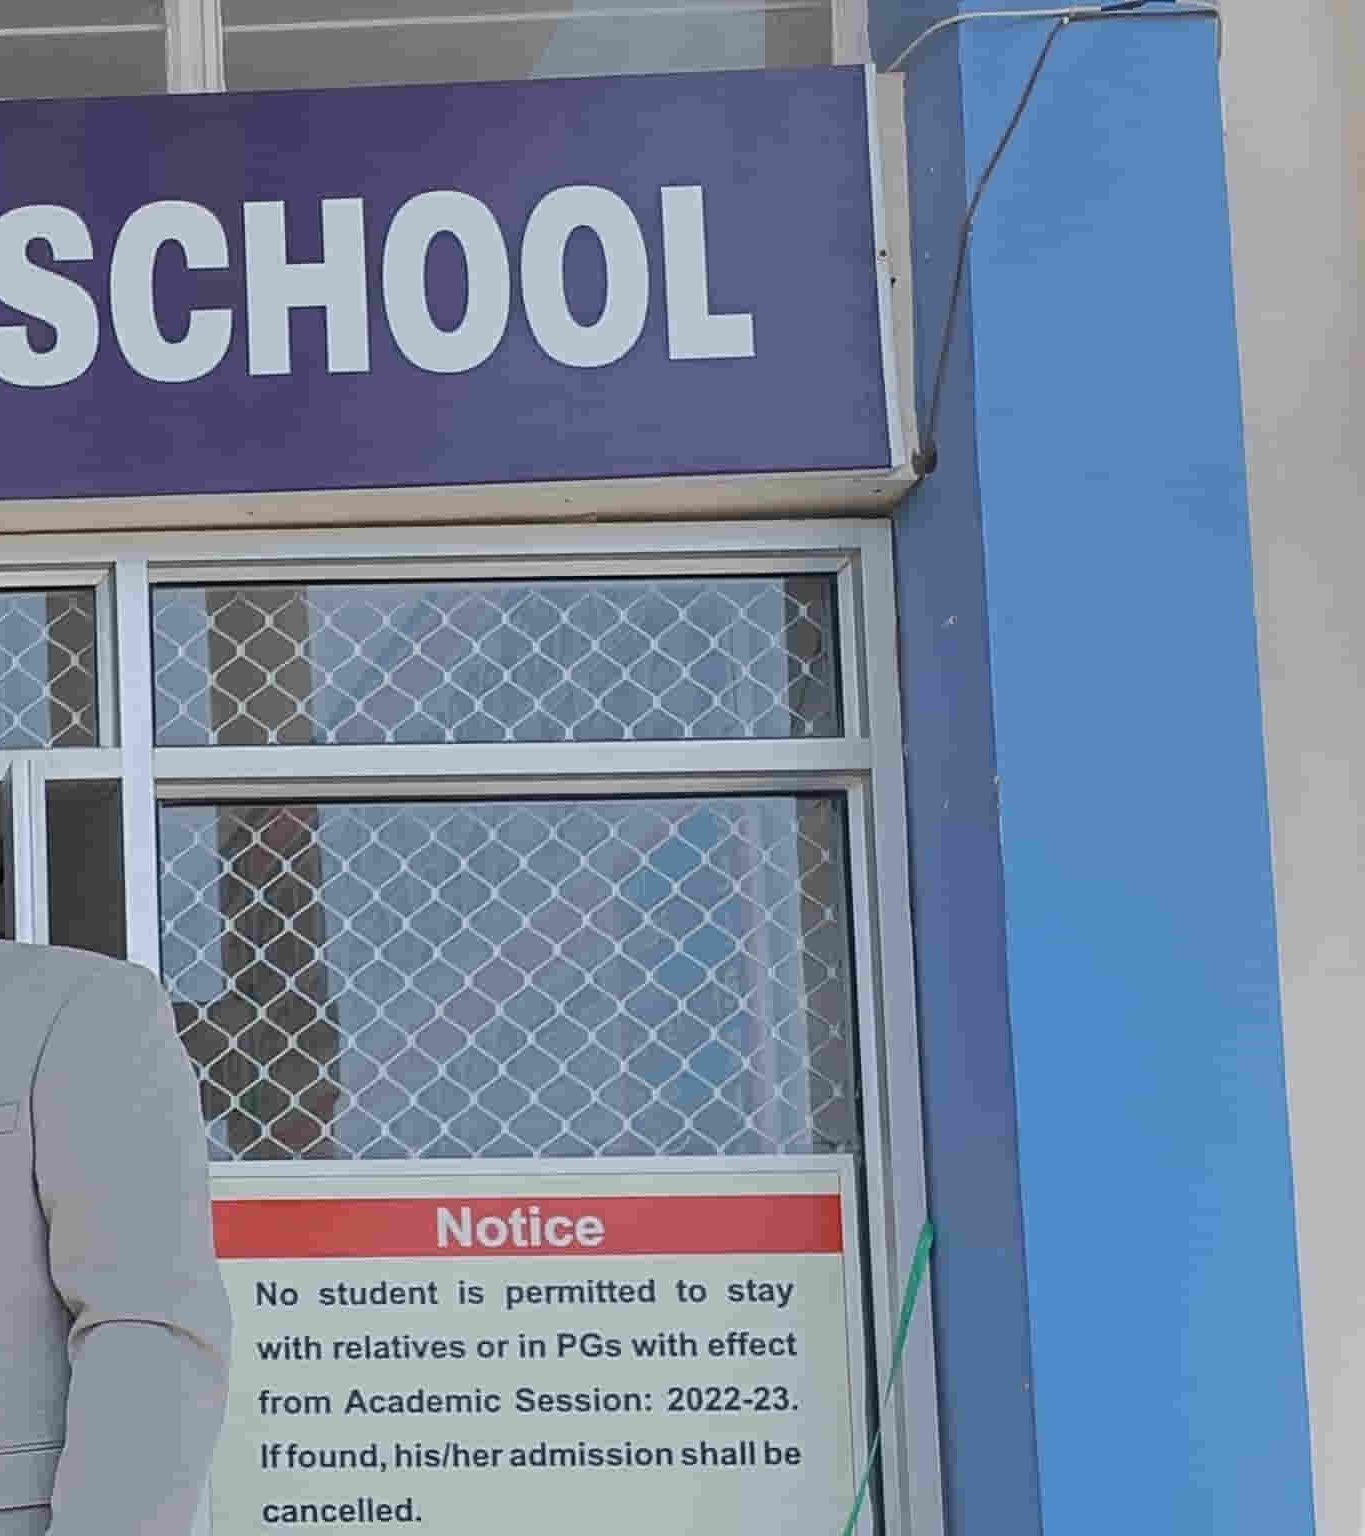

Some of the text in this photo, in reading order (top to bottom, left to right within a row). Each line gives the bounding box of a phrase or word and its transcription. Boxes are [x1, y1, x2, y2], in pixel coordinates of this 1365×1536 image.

[437, 1206, 604, 1248] Notice
[257, 1279, 793, 1310] No student is permitted to stay
[257, 1332, 797, 1360] with relatives or in PGs with effect
[258, 1386, 797, 1414] from Academic Session: 2022-23.
[262, 1441, 801, 1472] If found, his/her admission shall be
[263, 1498, 421, 1522] cancelled.
